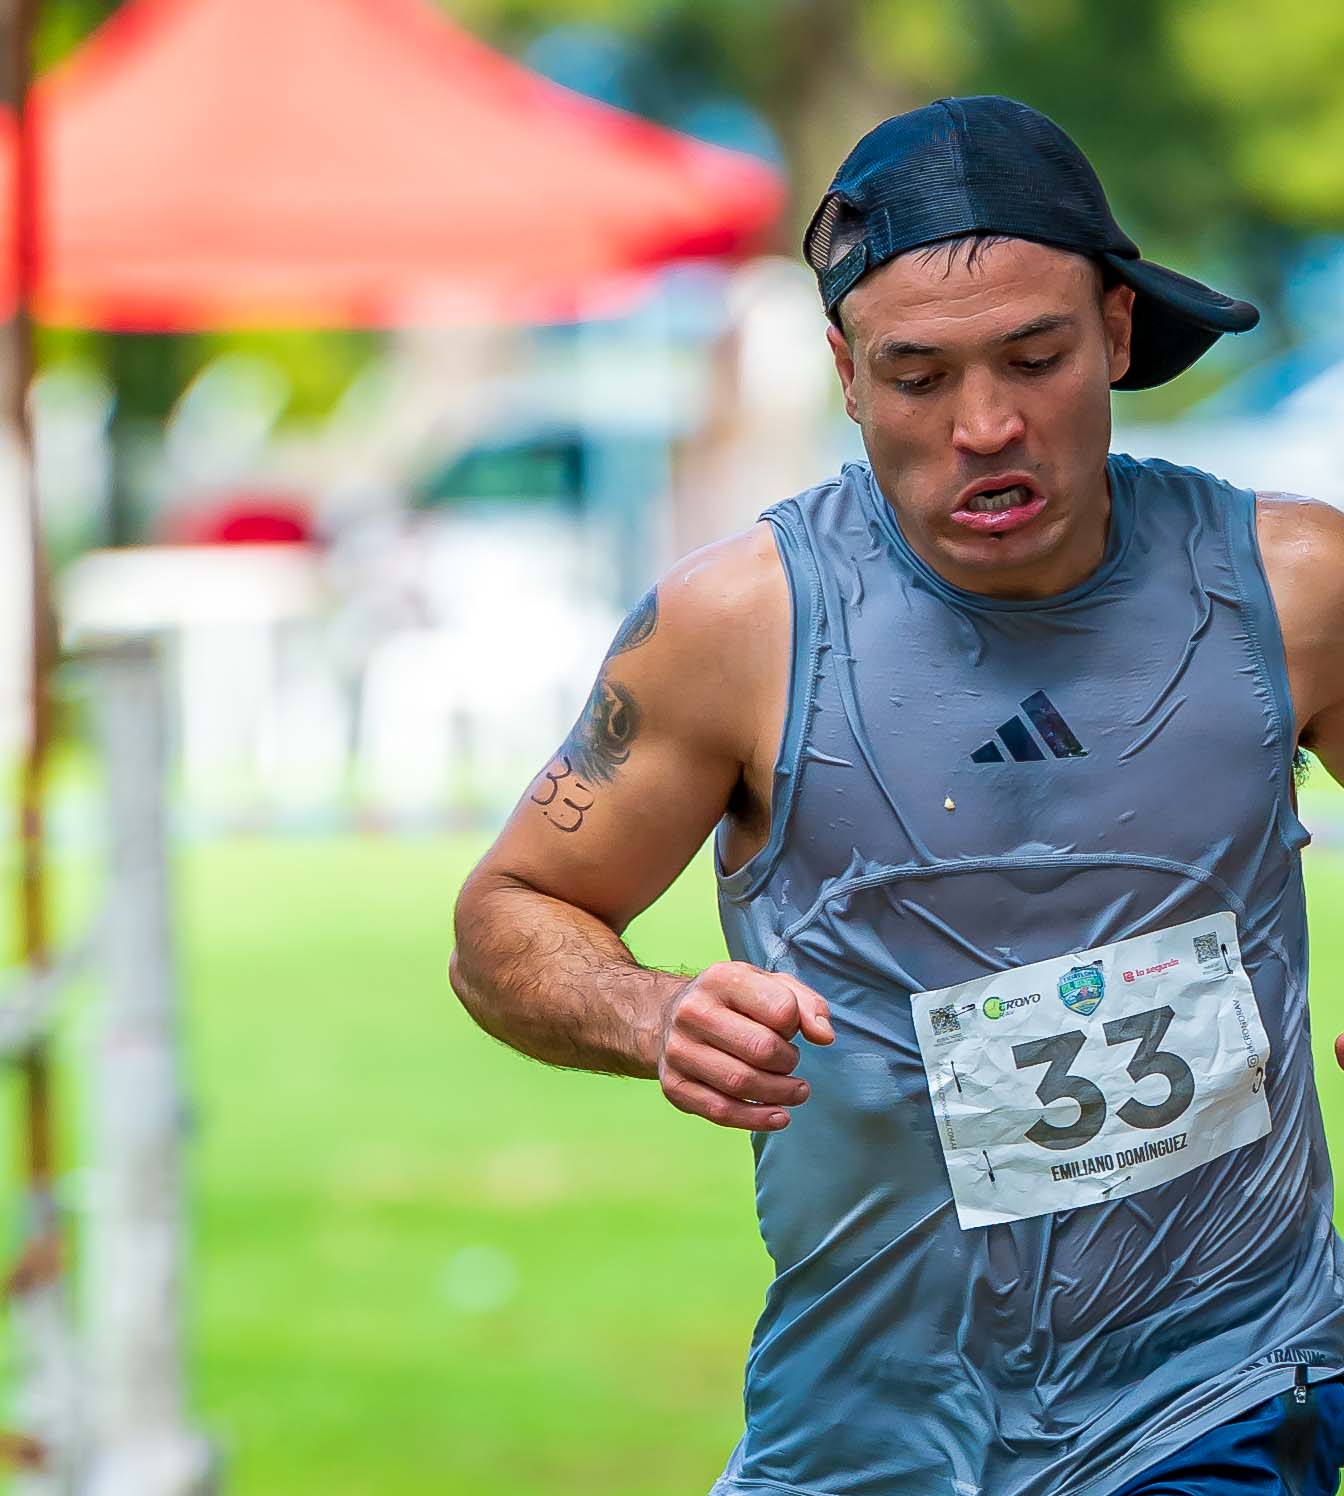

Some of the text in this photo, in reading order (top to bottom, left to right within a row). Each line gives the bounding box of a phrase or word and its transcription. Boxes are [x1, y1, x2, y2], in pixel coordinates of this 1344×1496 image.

[531, 756, 596, 832] 33
[1011, 1005, 1195, 1150] 33
[1051, 1132, 1188, 1181] EMILIANO DOMÍNGUEZ
